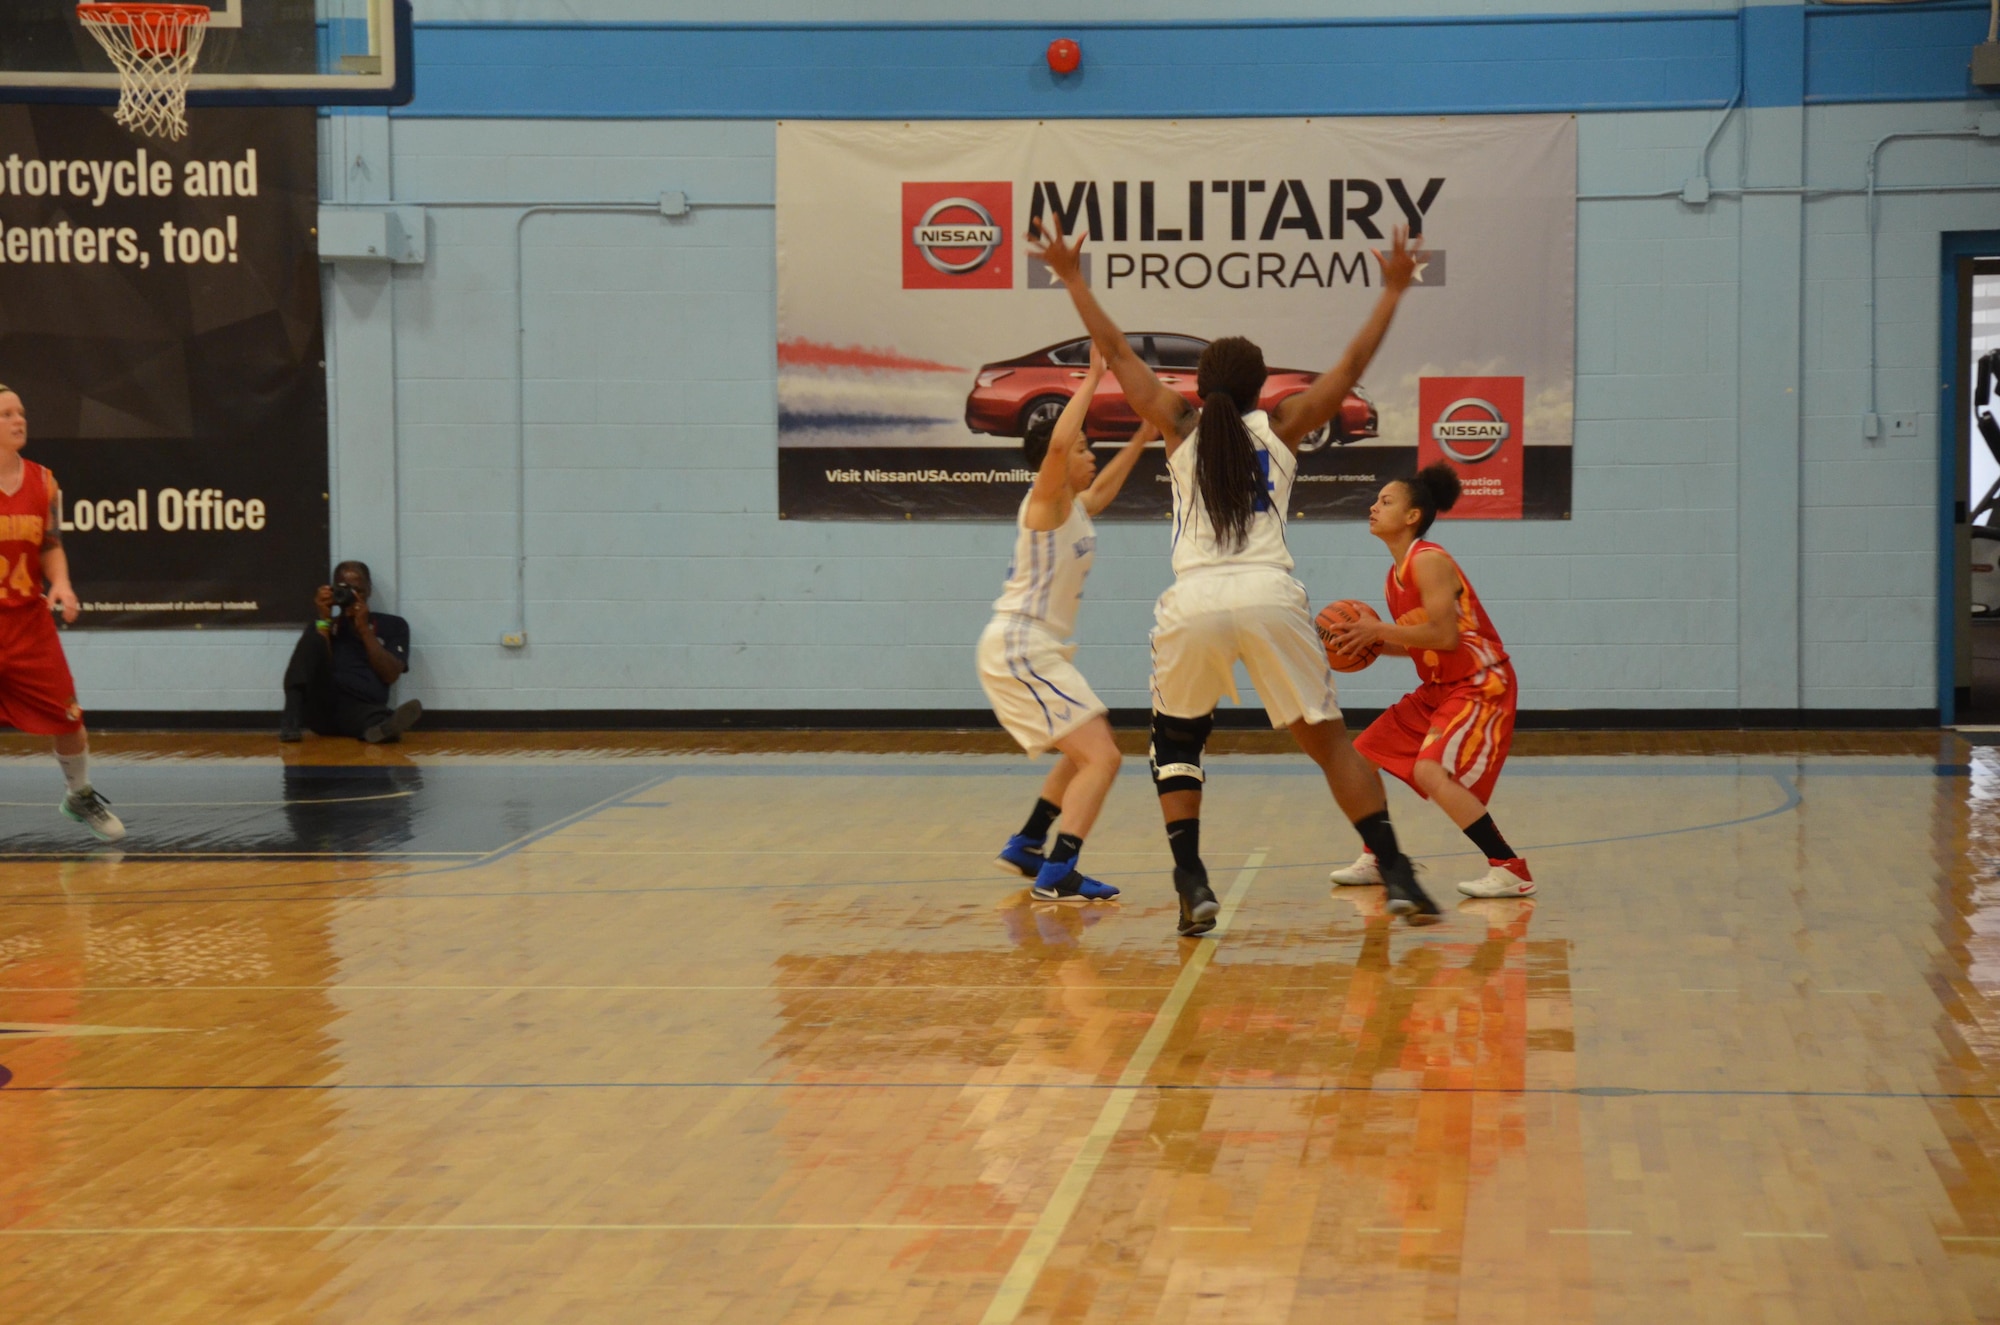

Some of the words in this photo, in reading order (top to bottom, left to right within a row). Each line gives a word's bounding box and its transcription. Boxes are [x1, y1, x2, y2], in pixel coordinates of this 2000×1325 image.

[0, 149, 173, 206] torcycle
[183, 149, 258, 197] and
[1027, 177, 1447, 242] MILITARY
[0, 219, 150, 269] enters,
[159, 215, 238, 263] too!
[921, 230, 994, 242] NISSAN
[1106, 251, 1371, 290] PROGRAM
[1439, 425, 1503, 436] NISSAN
[825, 468, 862, 482] Visit
[863, 468, 1039, 483] NissanUSA.com/milita
[1459, 477, 1502, 486] ovation
[1462, 486, 1505, 496] excites
[58, 488, 148, 531] Local
[157, 487, 266, 531] Office
